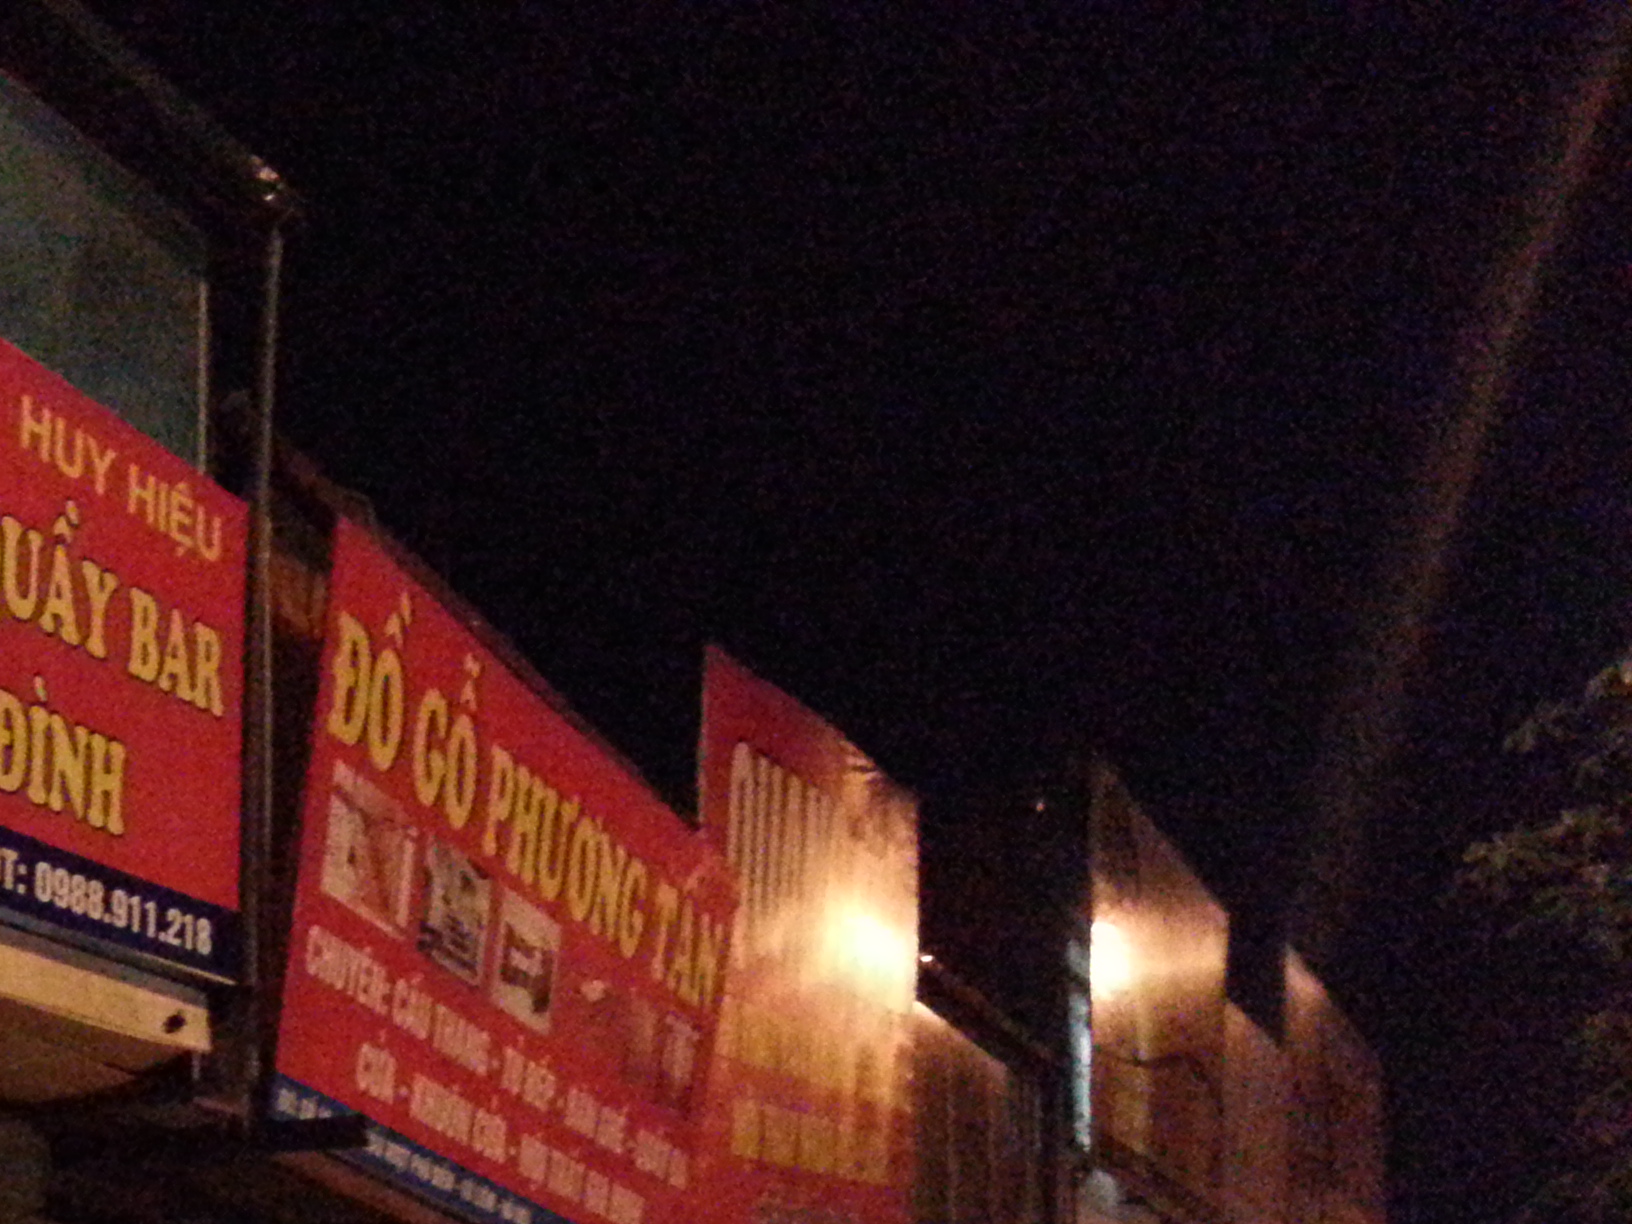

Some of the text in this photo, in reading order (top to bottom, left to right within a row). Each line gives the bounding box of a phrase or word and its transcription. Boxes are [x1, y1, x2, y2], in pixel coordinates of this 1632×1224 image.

[20, 394, 222, 563] HUY HIỆU
[128, 586, 224, 718] BAR
[326, 591, 412, 772] ĐỒ
[412, 650, 479, 831] GỖ
[483, 745, 648, 959] PHƯƠNG
[34, 861, 213, 956] 0988.911.218
